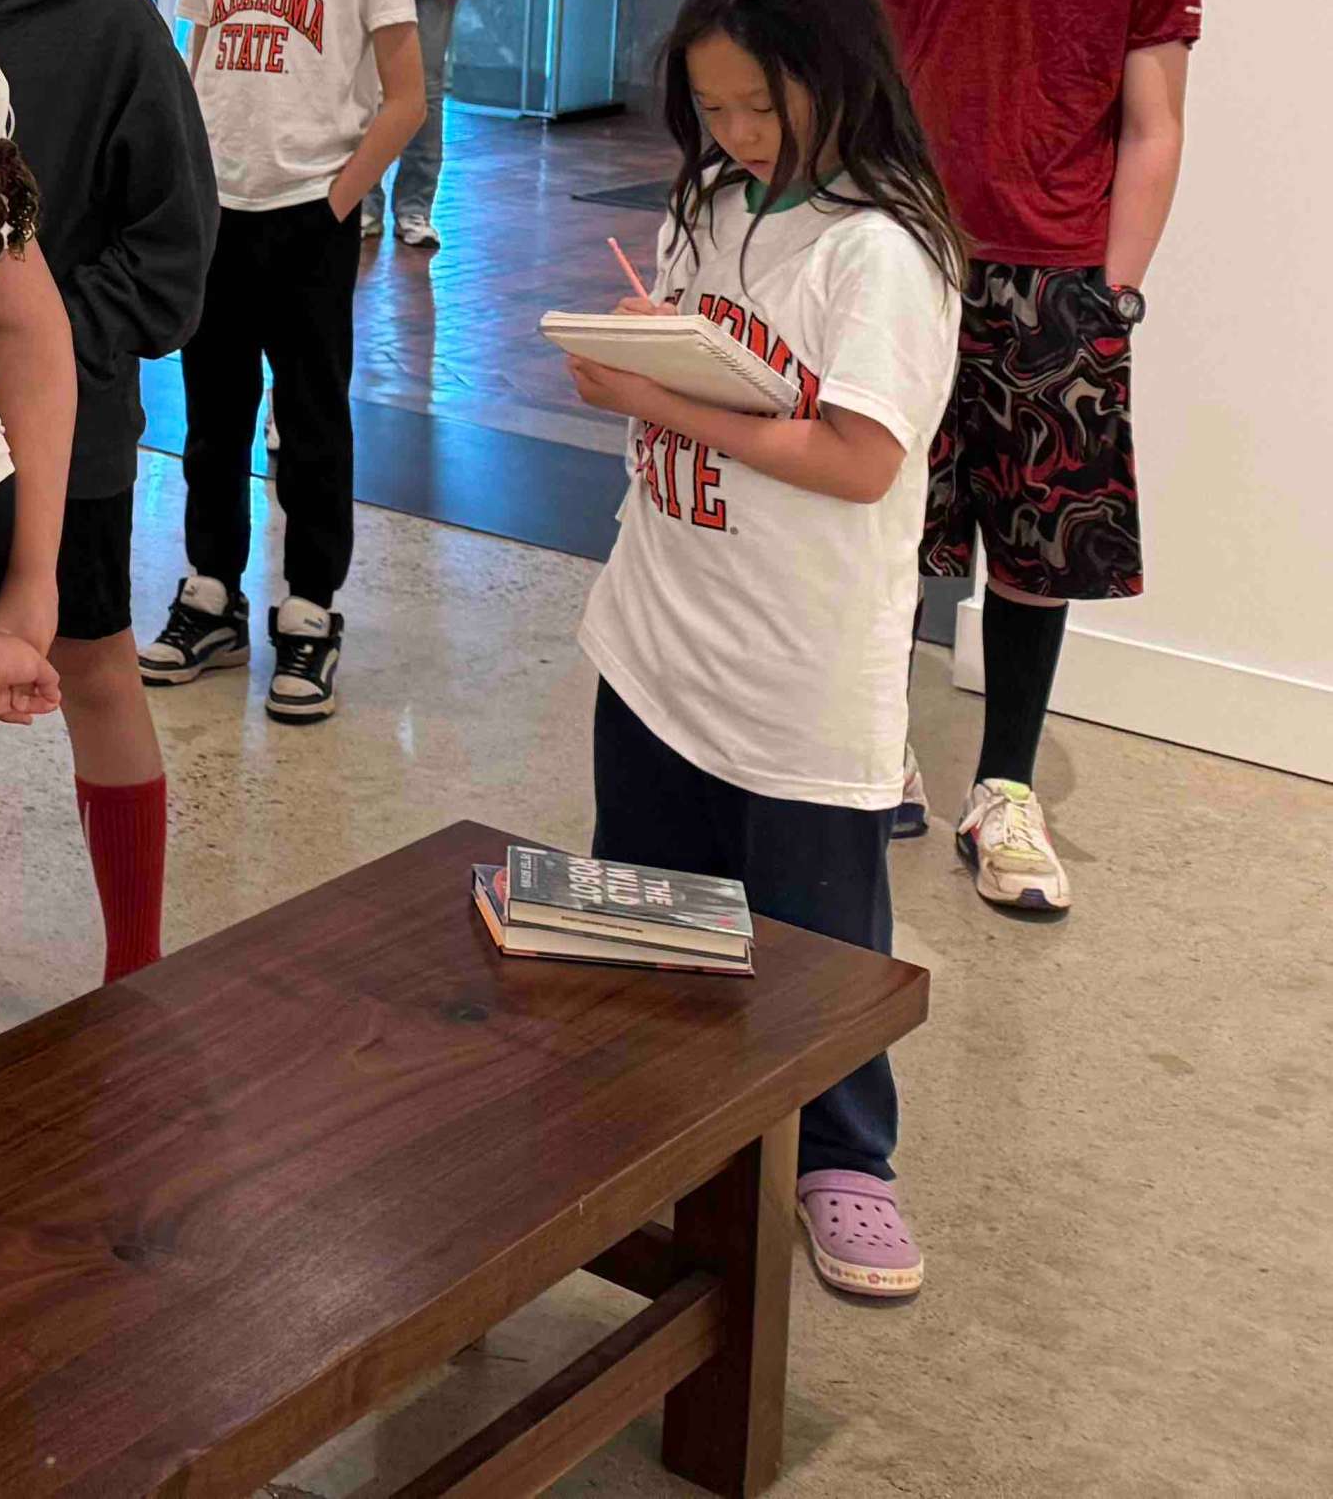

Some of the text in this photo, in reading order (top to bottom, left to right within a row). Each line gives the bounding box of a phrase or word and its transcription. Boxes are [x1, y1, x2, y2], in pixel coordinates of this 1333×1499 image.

[215, 23, 289, 74] STATE
[566, 856, 603, 905] ROBOT
[606, 867, 640, 906] WILD
[643, 878, 674, 907] THE
